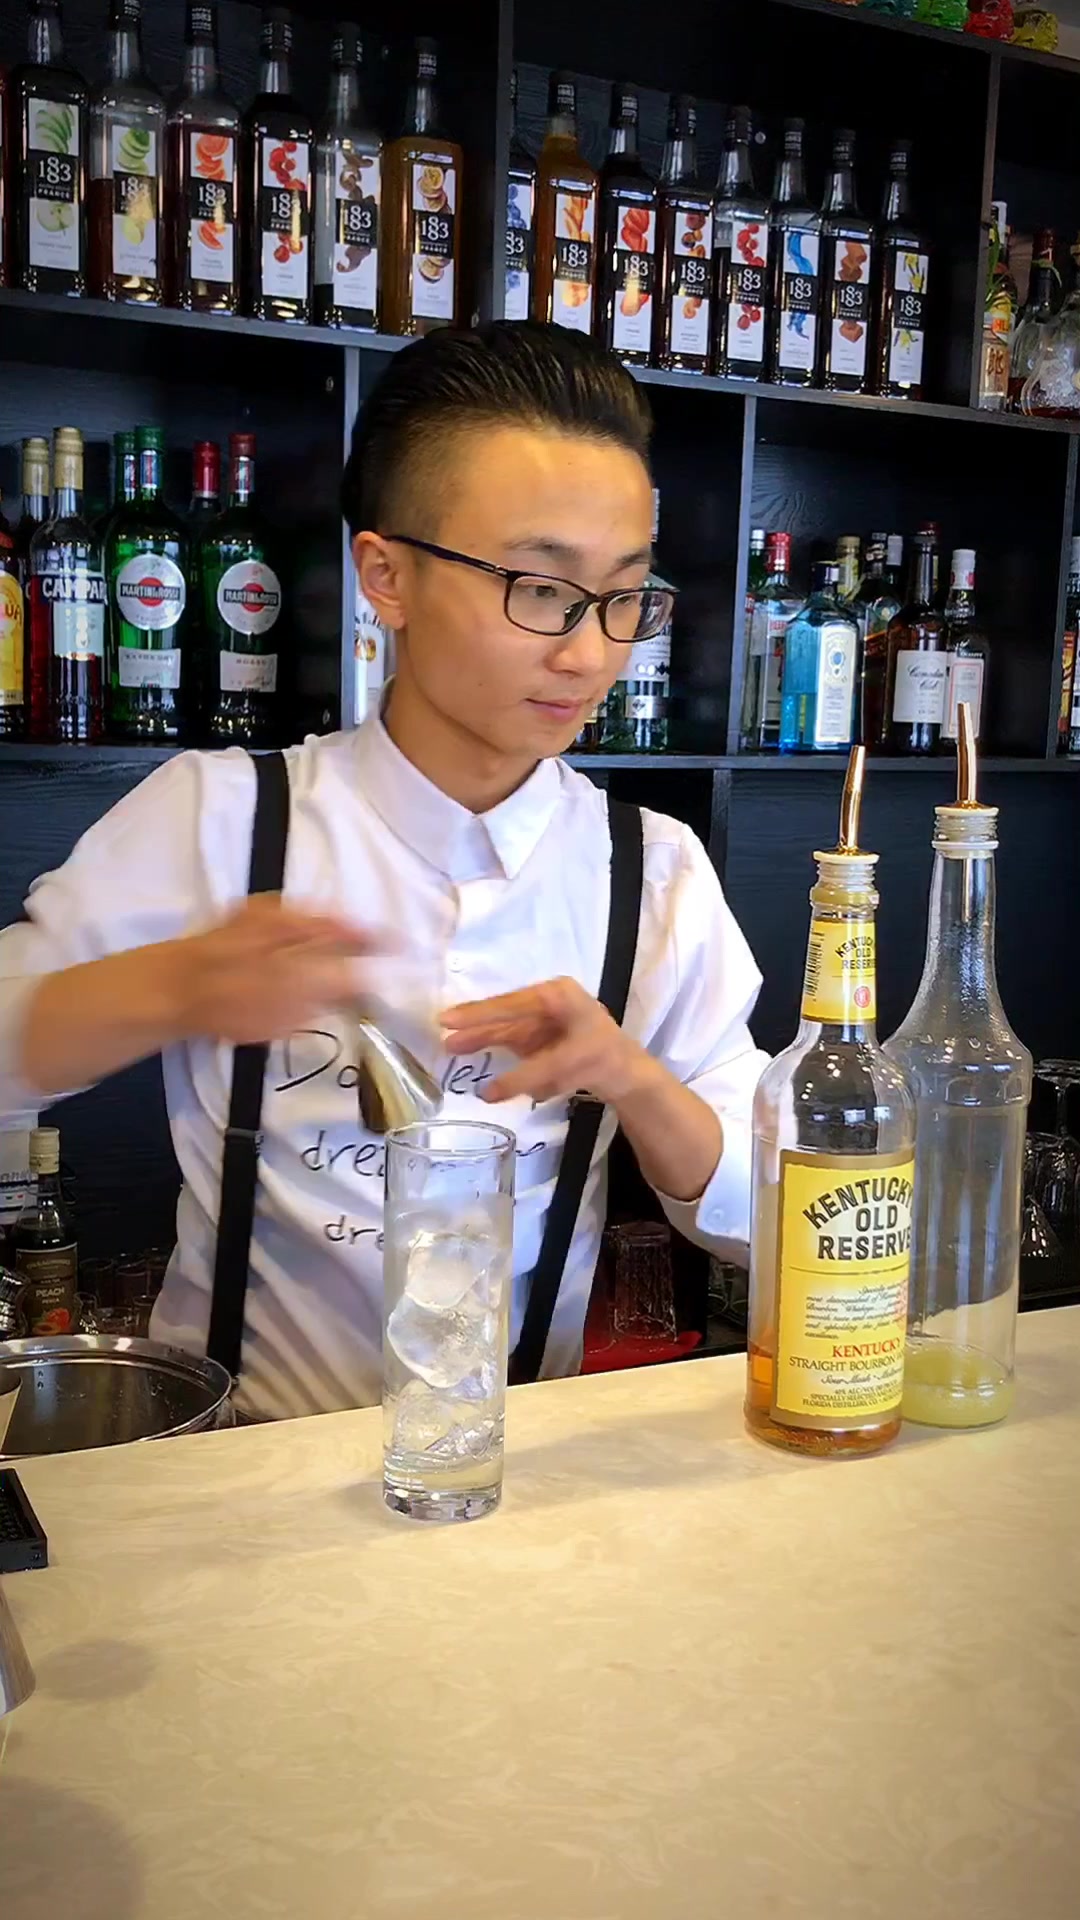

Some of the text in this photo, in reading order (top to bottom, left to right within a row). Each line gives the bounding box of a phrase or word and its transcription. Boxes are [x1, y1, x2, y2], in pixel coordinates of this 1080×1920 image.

[38, 188, 71, 199] FRANCE
[420, 243, 448, 253] FRANCE
[835, 936, 874, 958] KENTUC
[855, 947, 871, 958] OLD
[841, 959, 875, 969] RESER
[300, 1129, 386, 1177] dre
[802, 1176, 913, 1230] KENTUCKY
[855, 1204, 898, 1232] OLD
[817, 1227, 911, 1260] RESERVE
[35, 1286, 65, 1297] PEACH
[788, 1356, 847, 1372] STRAIGHT
[850, 1354, 896, 1372] BOURBON
[810, 1393, 846, 1401] SPECIALLY
[802, 1398, 832, 1408] FLORIDA
